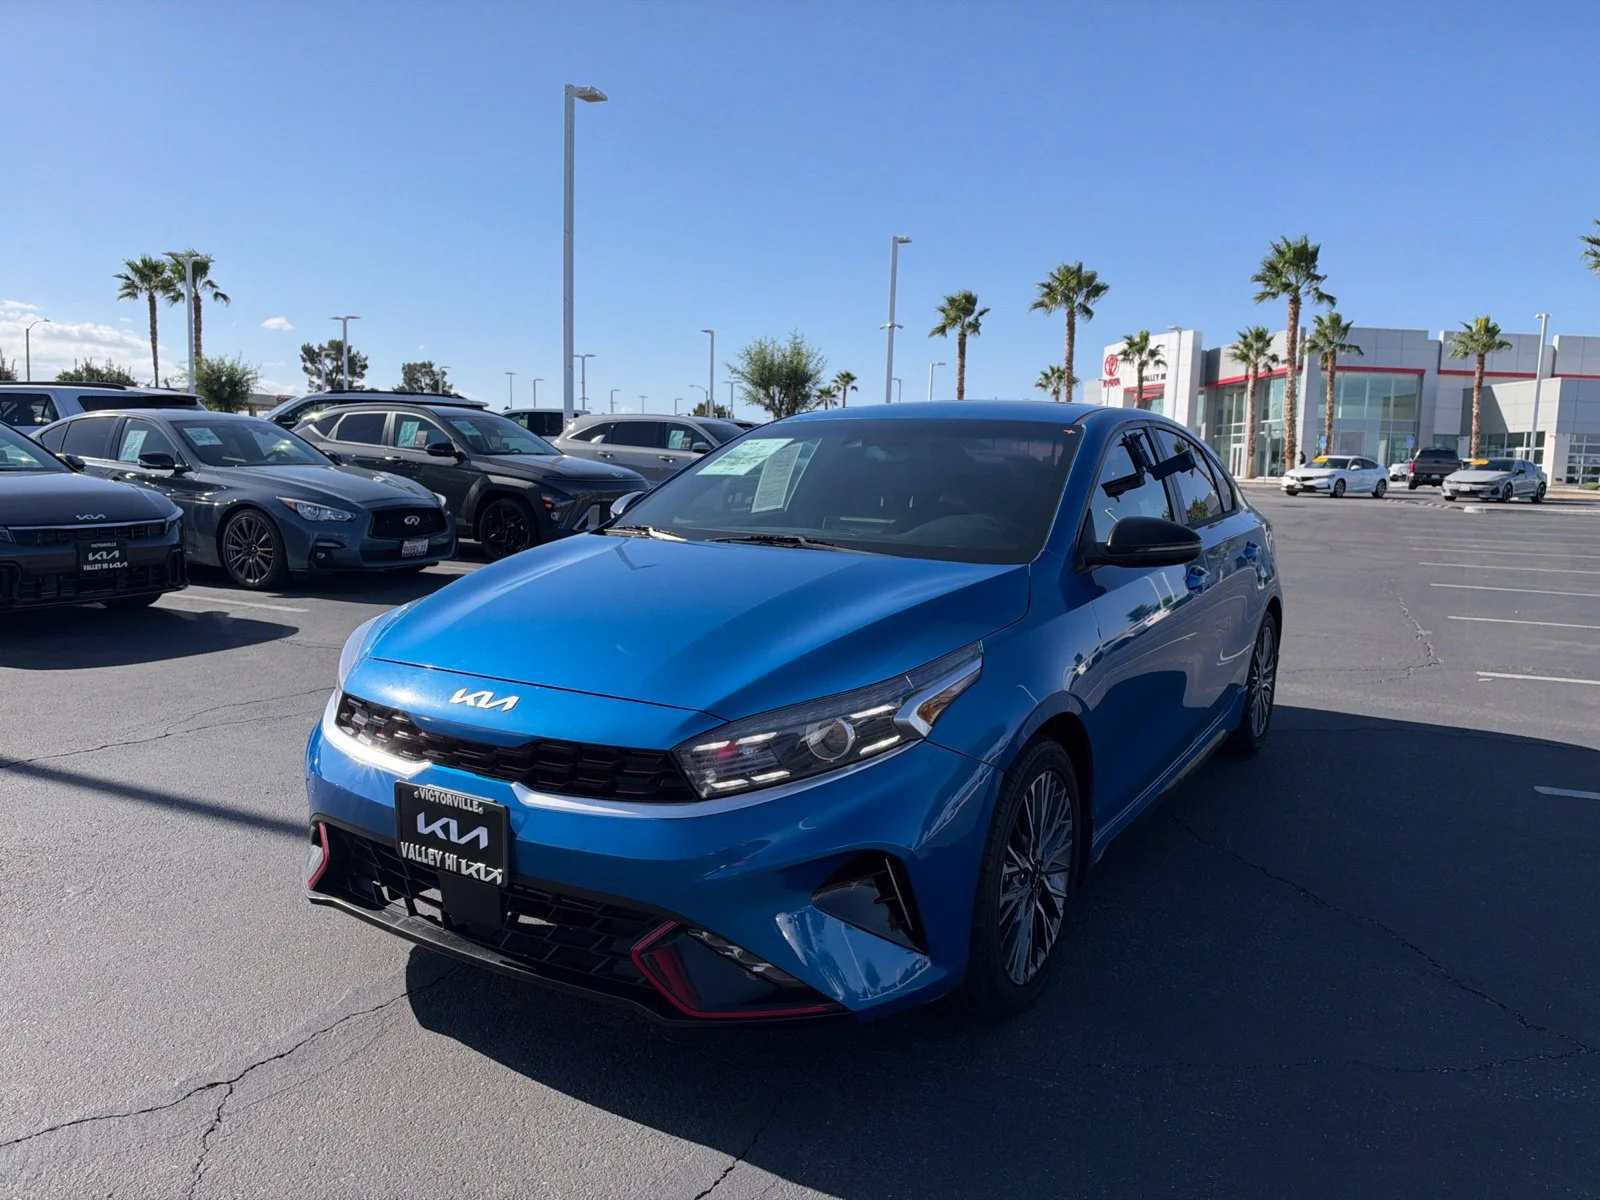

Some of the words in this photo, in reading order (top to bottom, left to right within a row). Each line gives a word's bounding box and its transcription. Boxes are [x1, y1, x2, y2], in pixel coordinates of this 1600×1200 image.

[83, 563, 102, 571] VALLEY
[88, 550, 120, 561] KIA
[449, 688, 520, 712] KIA
[419, 788, 480, 813] VICTORVILLE
[416, 811, 489, 850] KIA
[400, 841, 443, 868] VALLEY
[444, 852, 458, 872] HI
[459, 859, 503, 885] KIA
